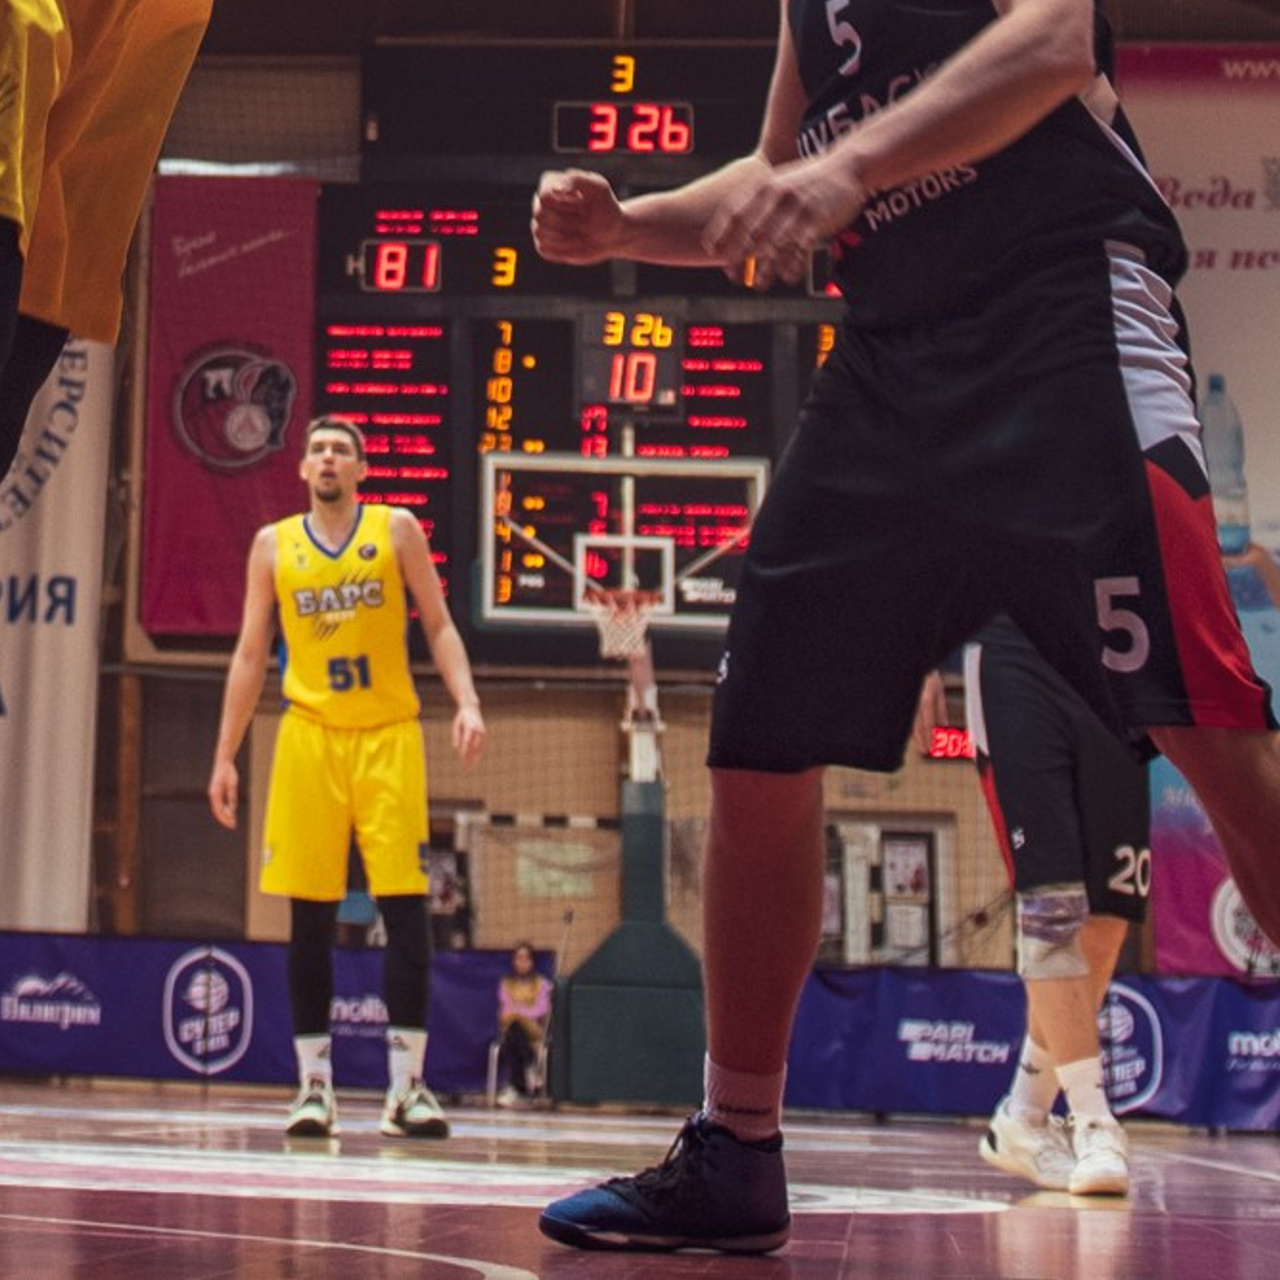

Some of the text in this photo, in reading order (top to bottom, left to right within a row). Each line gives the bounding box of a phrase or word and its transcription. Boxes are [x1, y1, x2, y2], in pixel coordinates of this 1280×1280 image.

[611, 54, 635, 92] 3
[863, 167, 977, 232] MOTORS
[375, 243, 439, 289] 81
[493, 247, 516, 286] 3
[609, 352, 656, 403] 10
[295, 578, 384, 618] БАРС
[1094, 576, 1150, 672] 5
[328, 655, 370, 691] 51
[1109, 845, 1152, 898] 20
[908, 1041, 1010, 1064] MATCH
